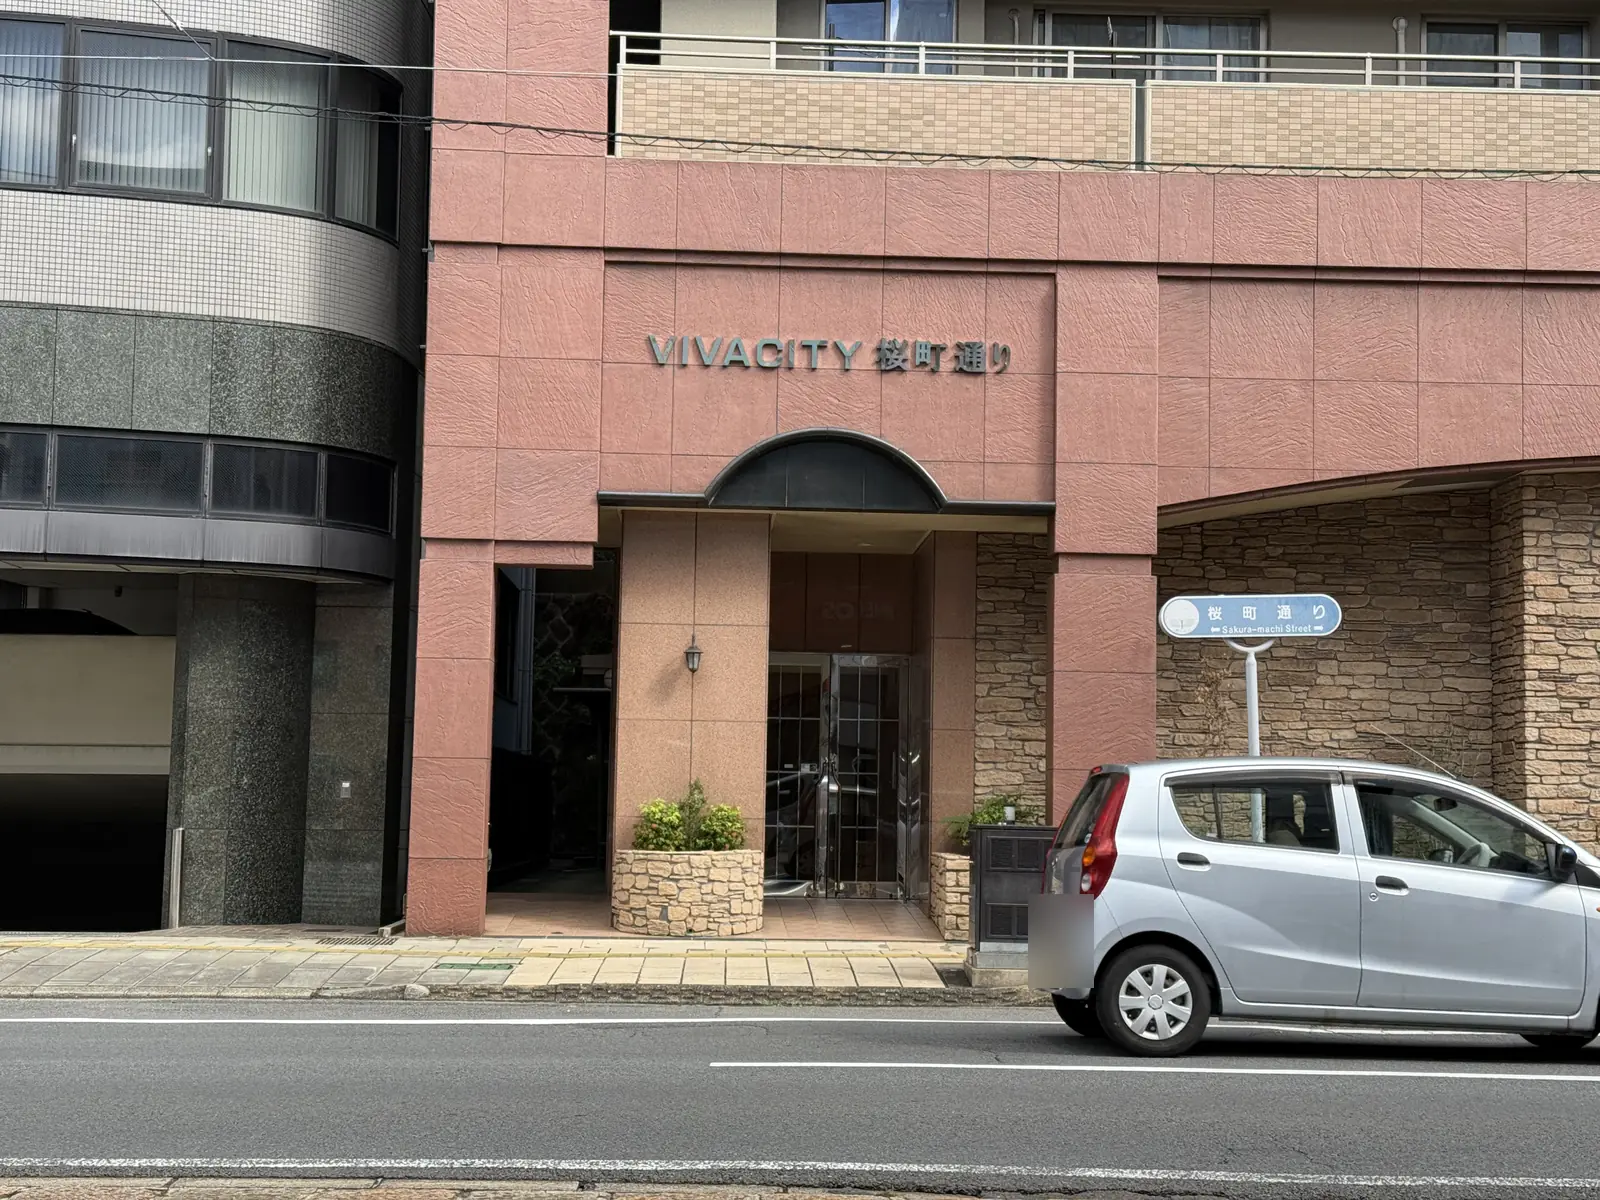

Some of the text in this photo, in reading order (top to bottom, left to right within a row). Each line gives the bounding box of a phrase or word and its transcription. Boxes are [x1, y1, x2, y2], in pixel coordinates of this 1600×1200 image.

[648, 334, 1011, 374] VIVACITY 桜町通り
[1207, 604, 1326, 621] 桜町通り
[1221, 624, 1312, 634] Sakura-machi Street
